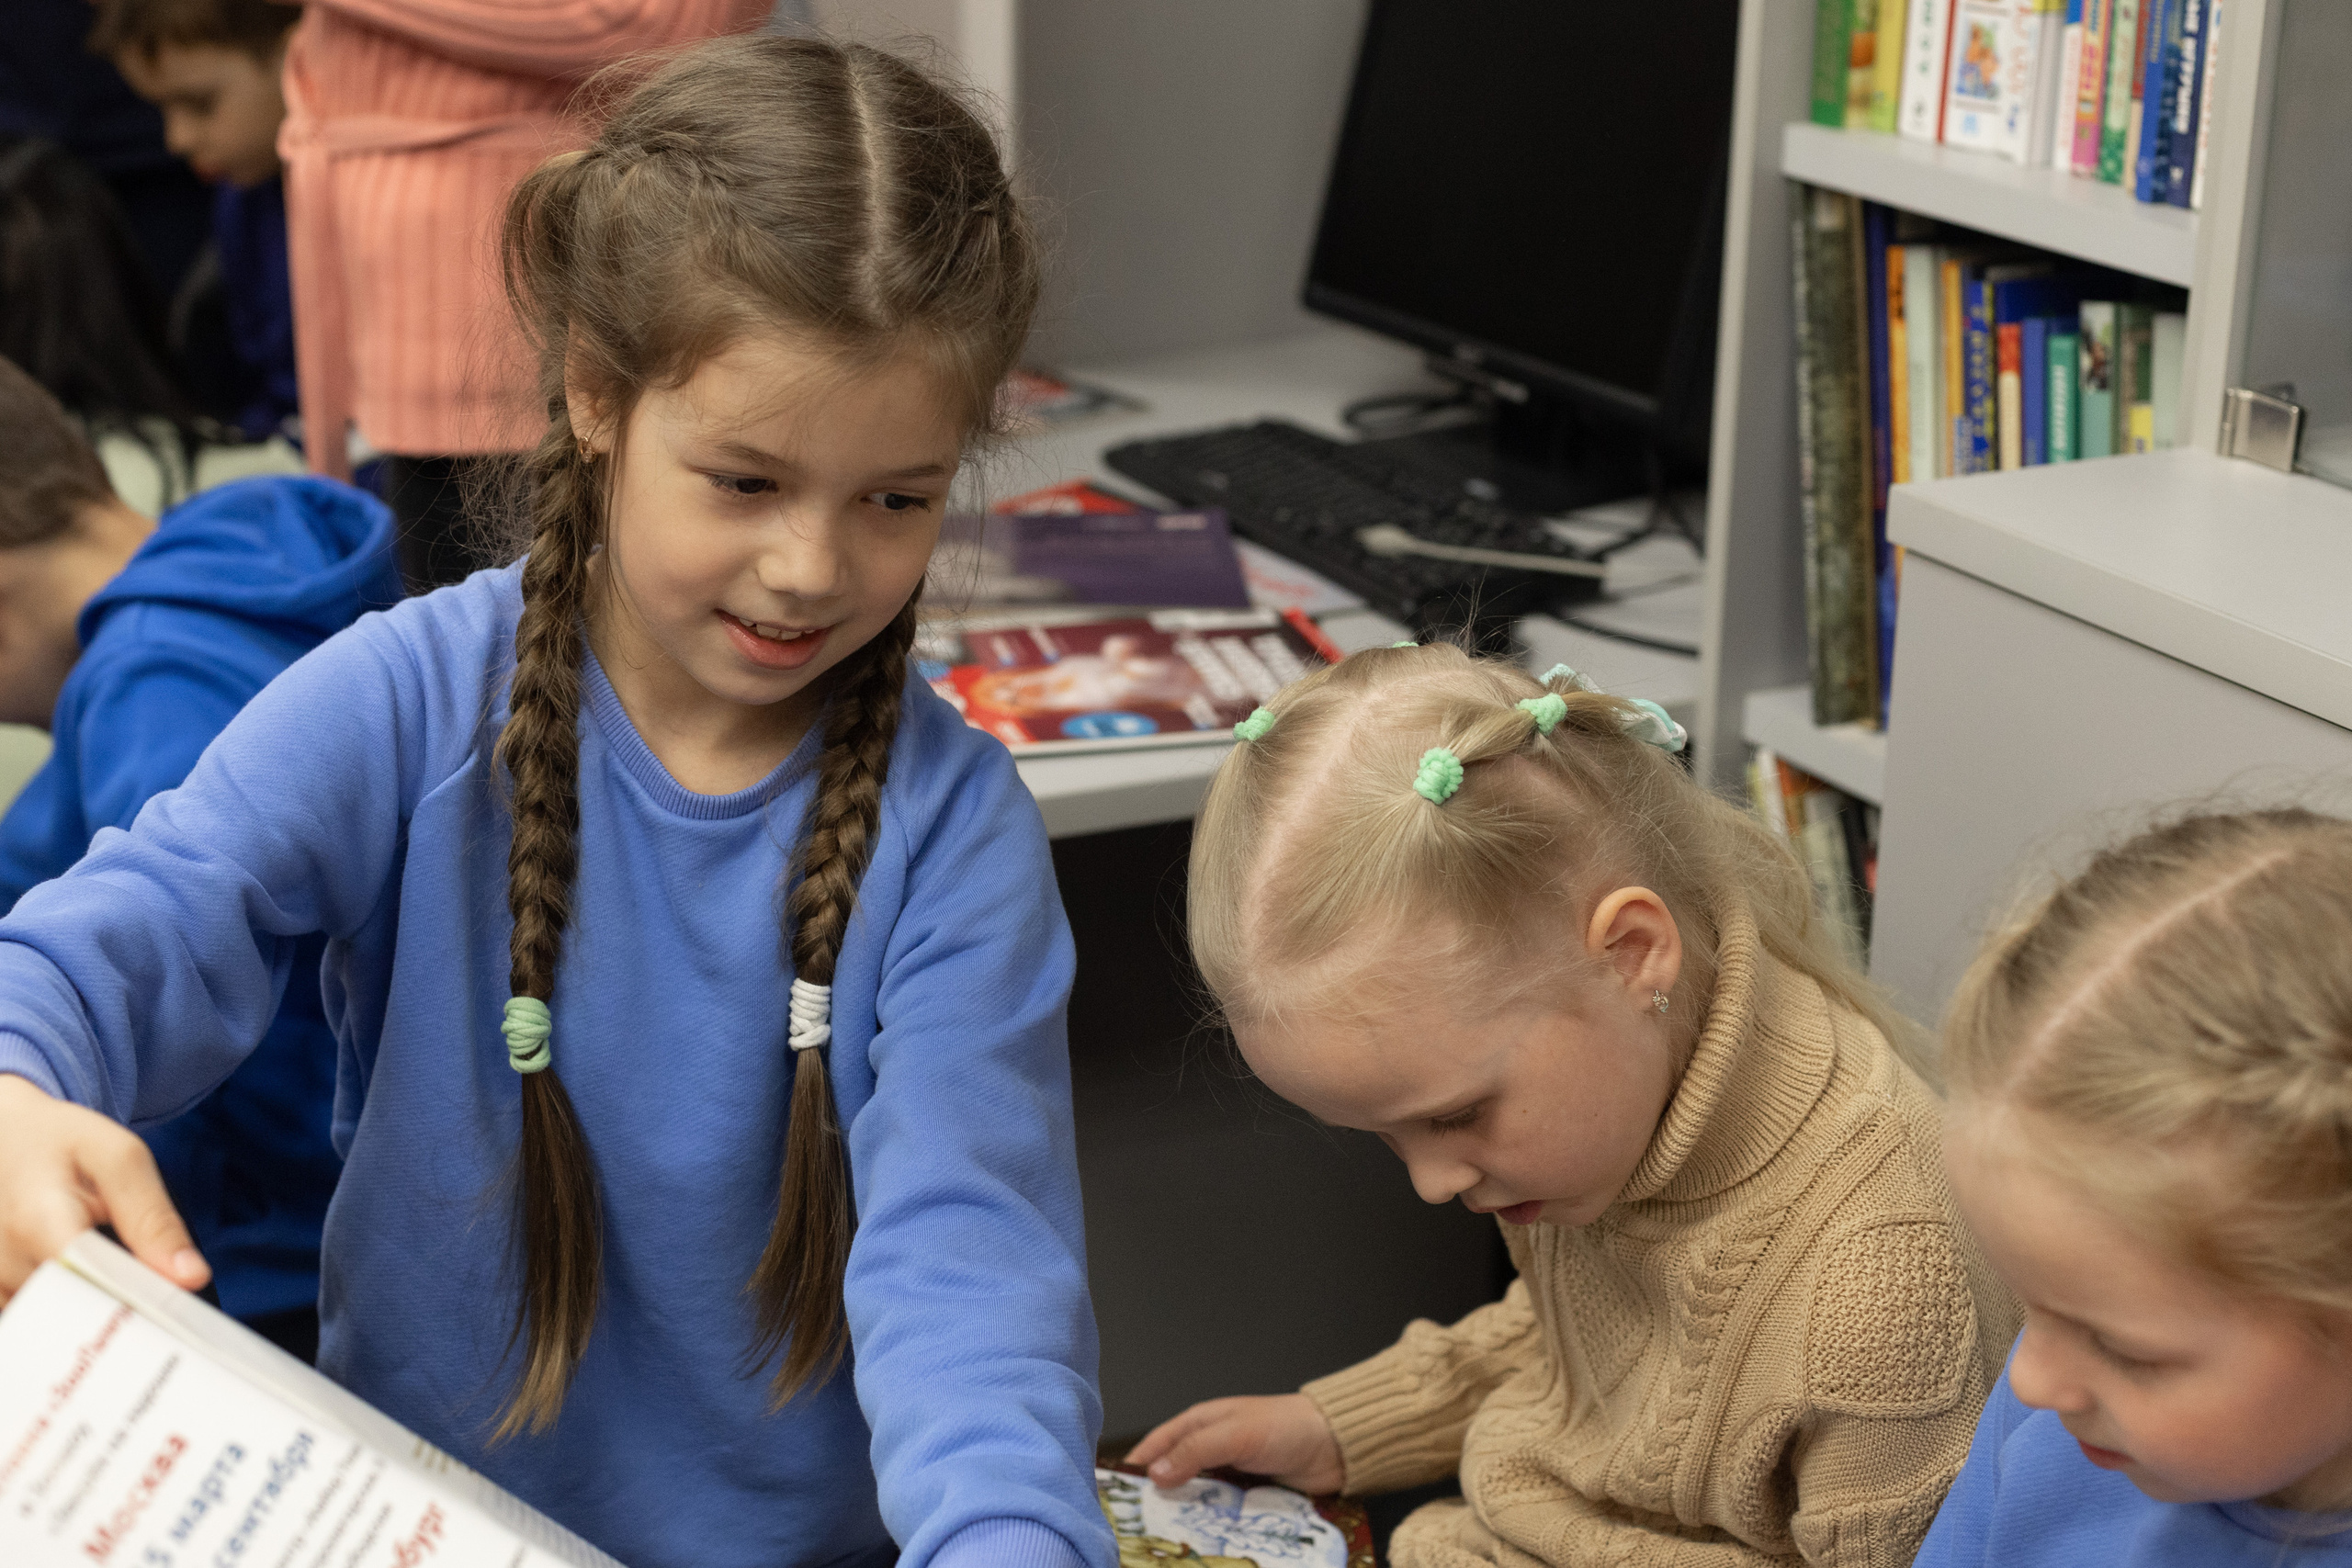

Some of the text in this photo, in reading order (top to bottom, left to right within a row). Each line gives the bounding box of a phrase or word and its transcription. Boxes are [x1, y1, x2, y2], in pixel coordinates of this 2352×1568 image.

[83, 1435, 188, 1567] Москва
[169, 1441, 246, 1547] марта
[390, 1501, 447, 1568] бург
